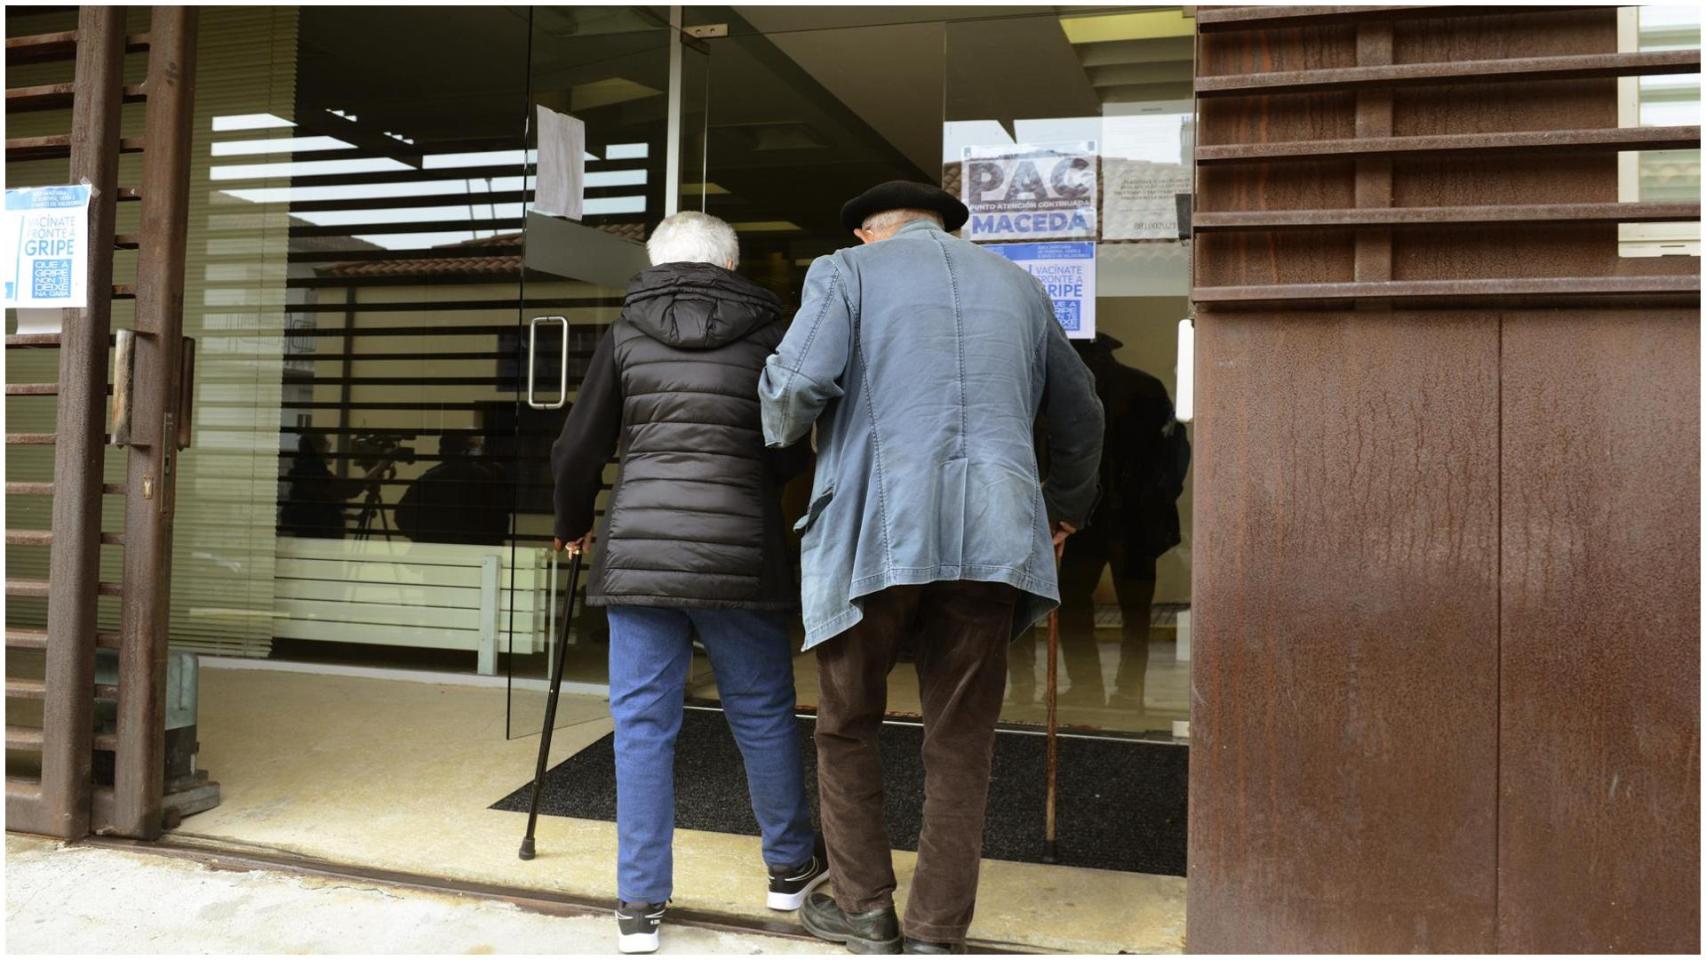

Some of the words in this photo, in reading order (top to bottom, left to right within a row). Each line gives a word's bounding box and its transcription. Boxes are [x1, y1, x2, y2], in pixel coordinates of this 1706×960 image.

[968, 158, 1090, 204] PAC
[996, 200, 1037, 209] ATENCIÓN
[972, 212, 1088, 234] MACEDA
[24, 239, 74, 256] GRIPE
[1036, 264, 1082, 275] VACÍNATE
[1076, 275, 1083, 283] A
[1047, 284, 1083, 297] RIPE
